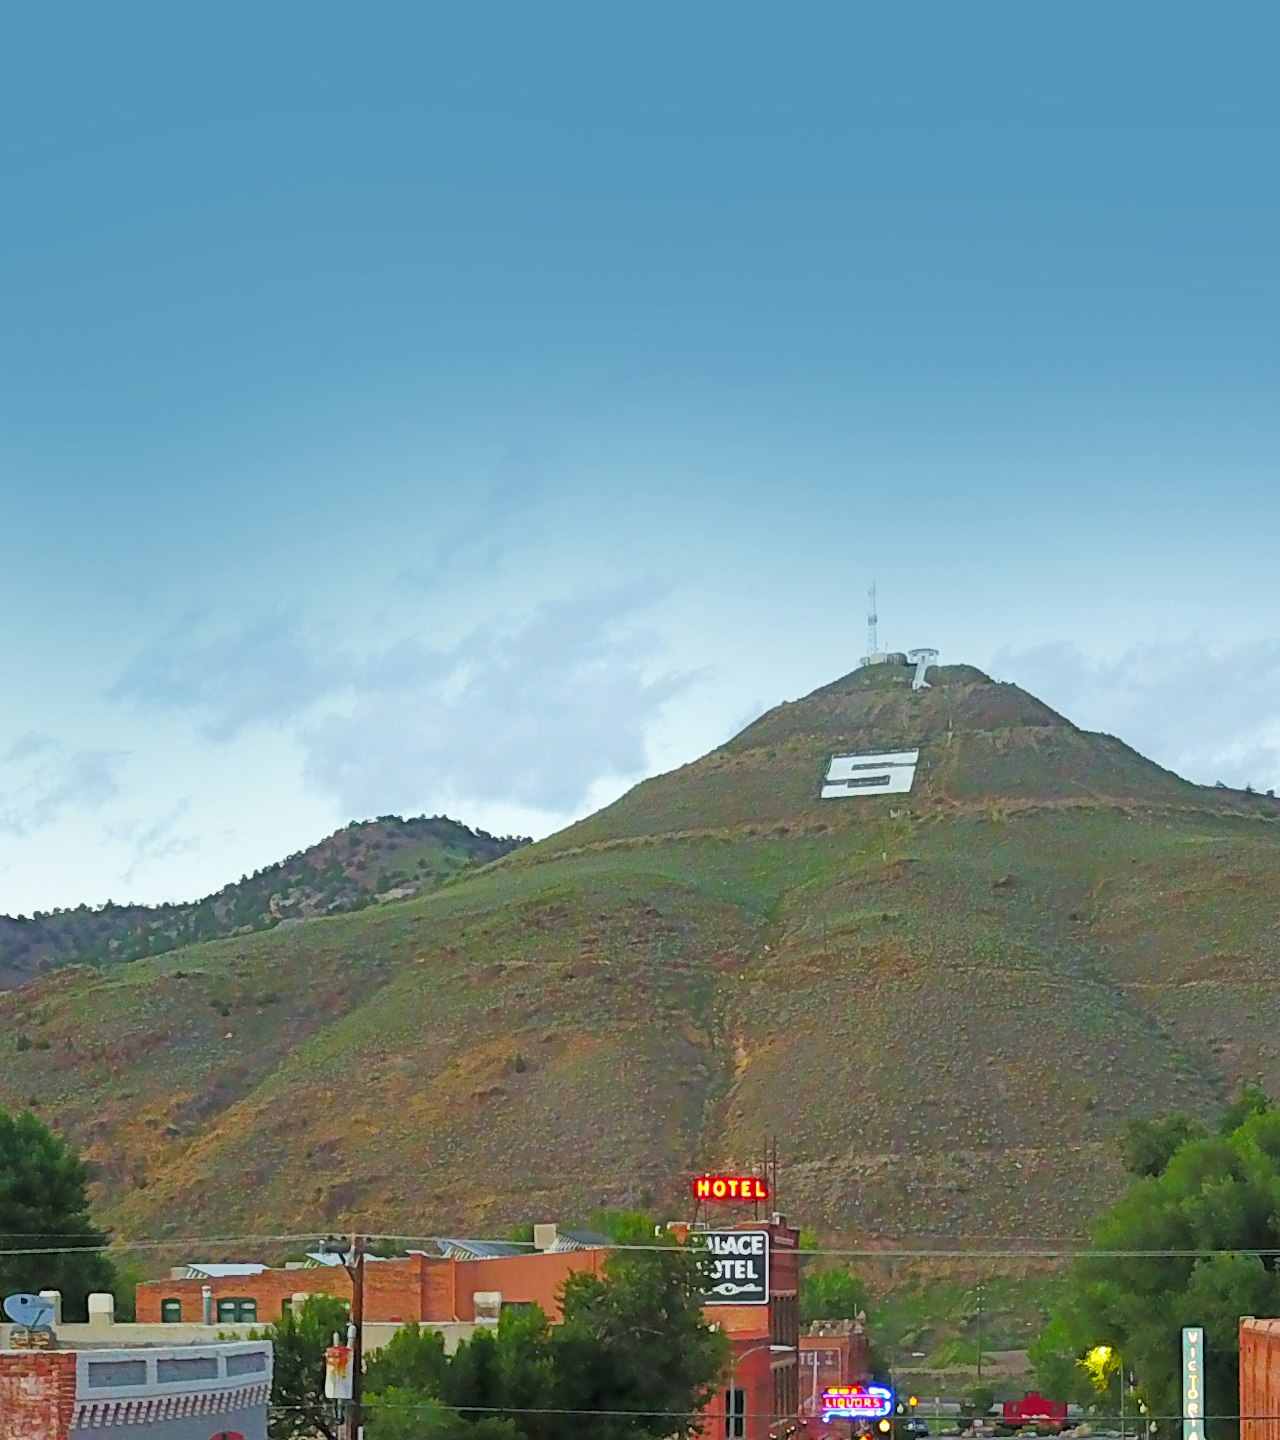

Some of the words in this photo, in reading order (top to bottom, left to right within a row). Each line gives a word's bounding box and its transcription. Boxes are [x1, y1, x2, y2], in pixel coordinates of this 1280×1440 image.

[821, 750, 919, 798] S
[697, 1180, 765, 1197] HOTEL
[698, 1260, 759, 1279] OTEL
[825, 1398, 881, 1408] LIQUORS
